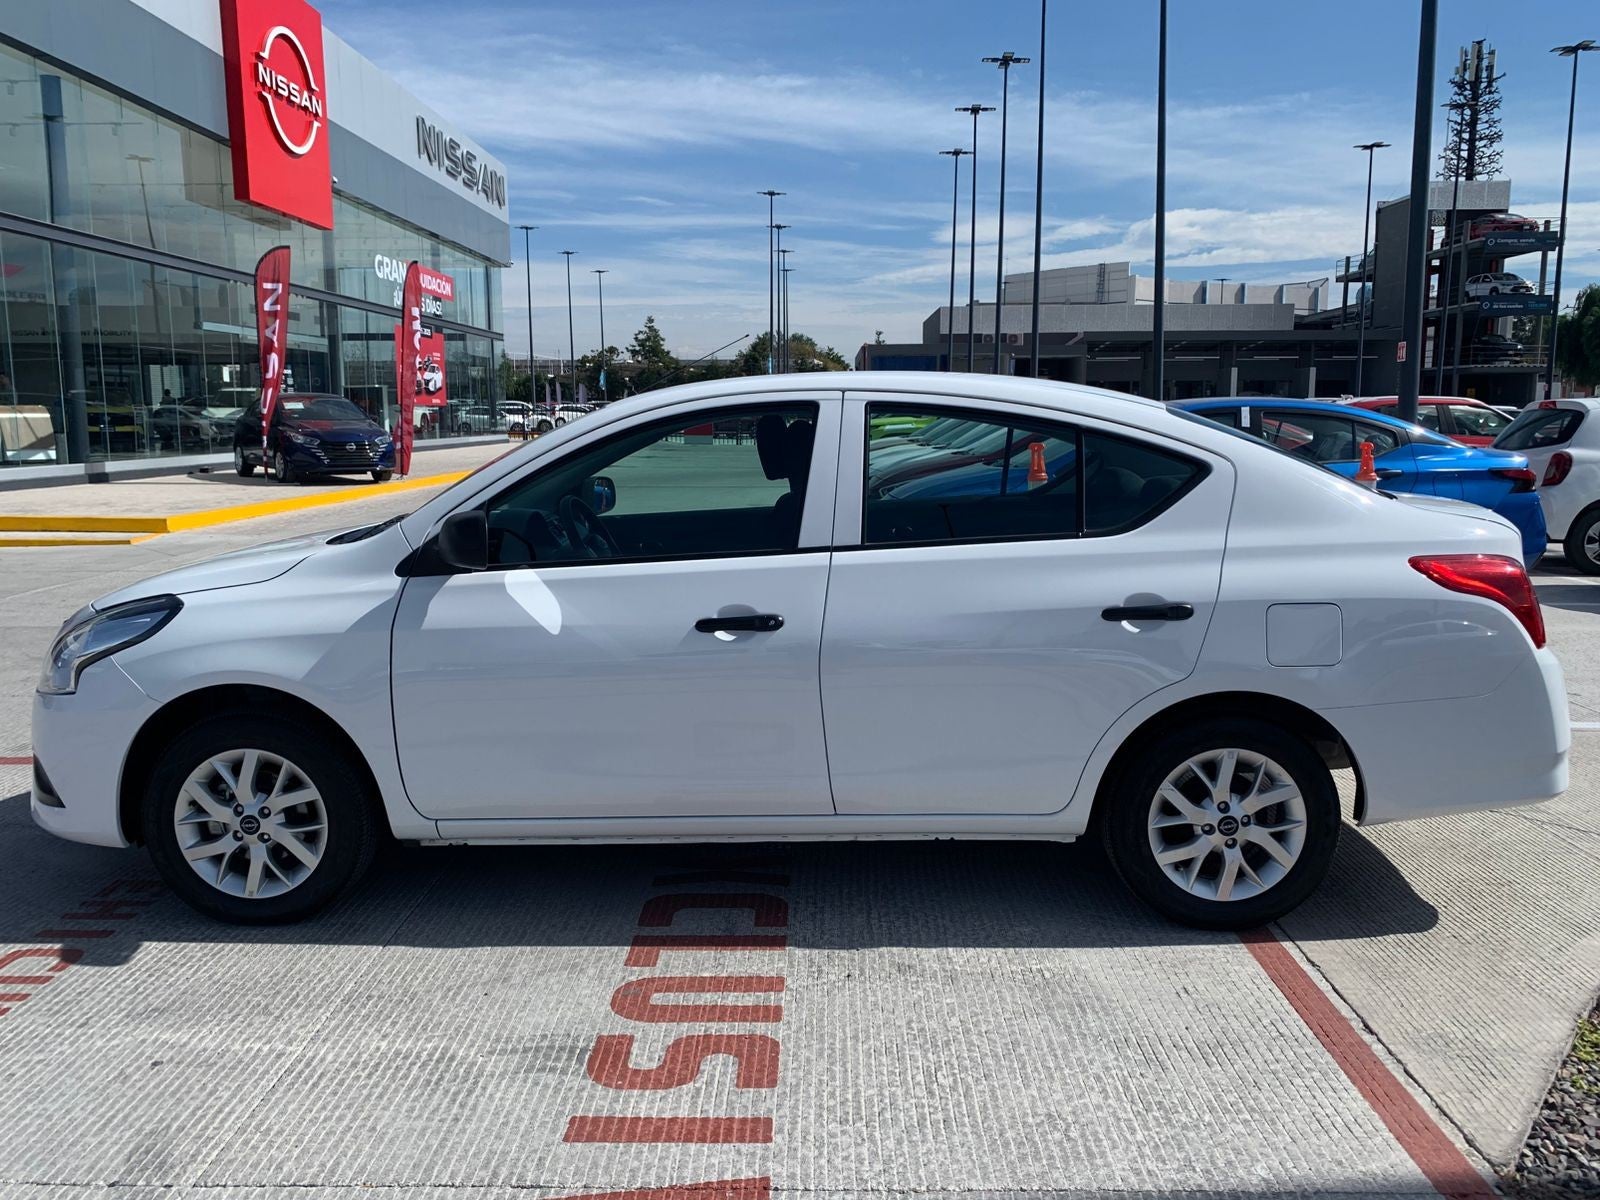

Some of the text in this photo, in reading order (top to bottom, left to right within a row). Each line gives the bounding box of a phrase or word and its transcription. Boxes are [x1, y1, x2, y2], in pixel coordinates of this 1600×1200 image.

[257, 62, 322, 117] NISSAN
[416, 115, 506, 209] NISSAN
[374, 254, 407, 284] GRAN
[420, 272, 452, 297] UIDACIÓN
